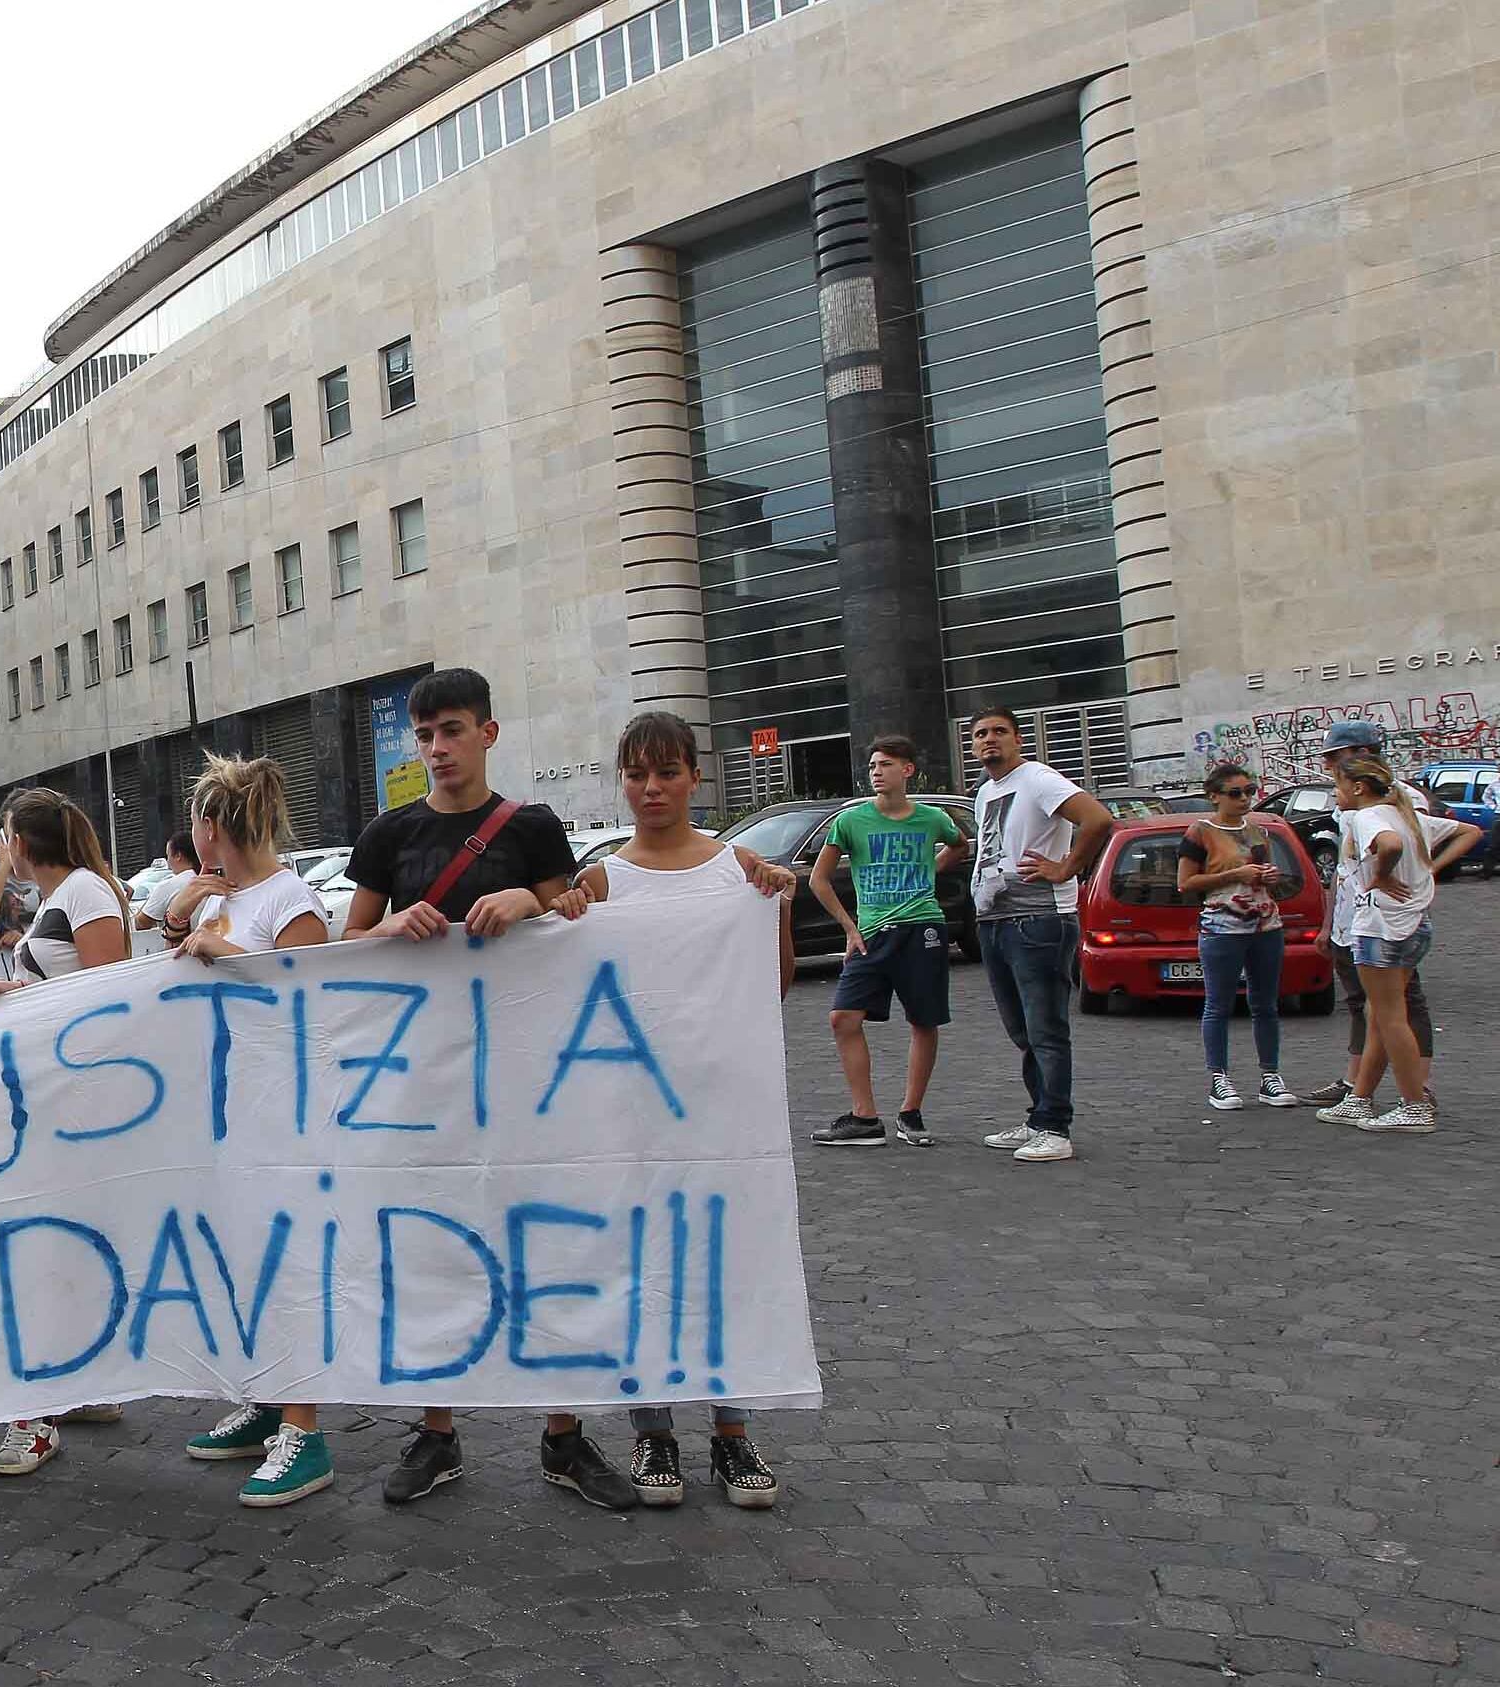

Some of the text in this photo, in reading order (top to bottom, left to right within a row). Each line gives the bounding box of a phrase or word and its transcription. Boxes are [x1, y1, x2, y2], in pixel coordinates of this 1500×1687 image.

[1246, 673, 1264, 689] E
[753, 731, 776, 744] TAXI
[534, 761, 600, 781] POSTE
[868, 832, 927, 862] WEST
[1171, 964, 1190, 977] CG
